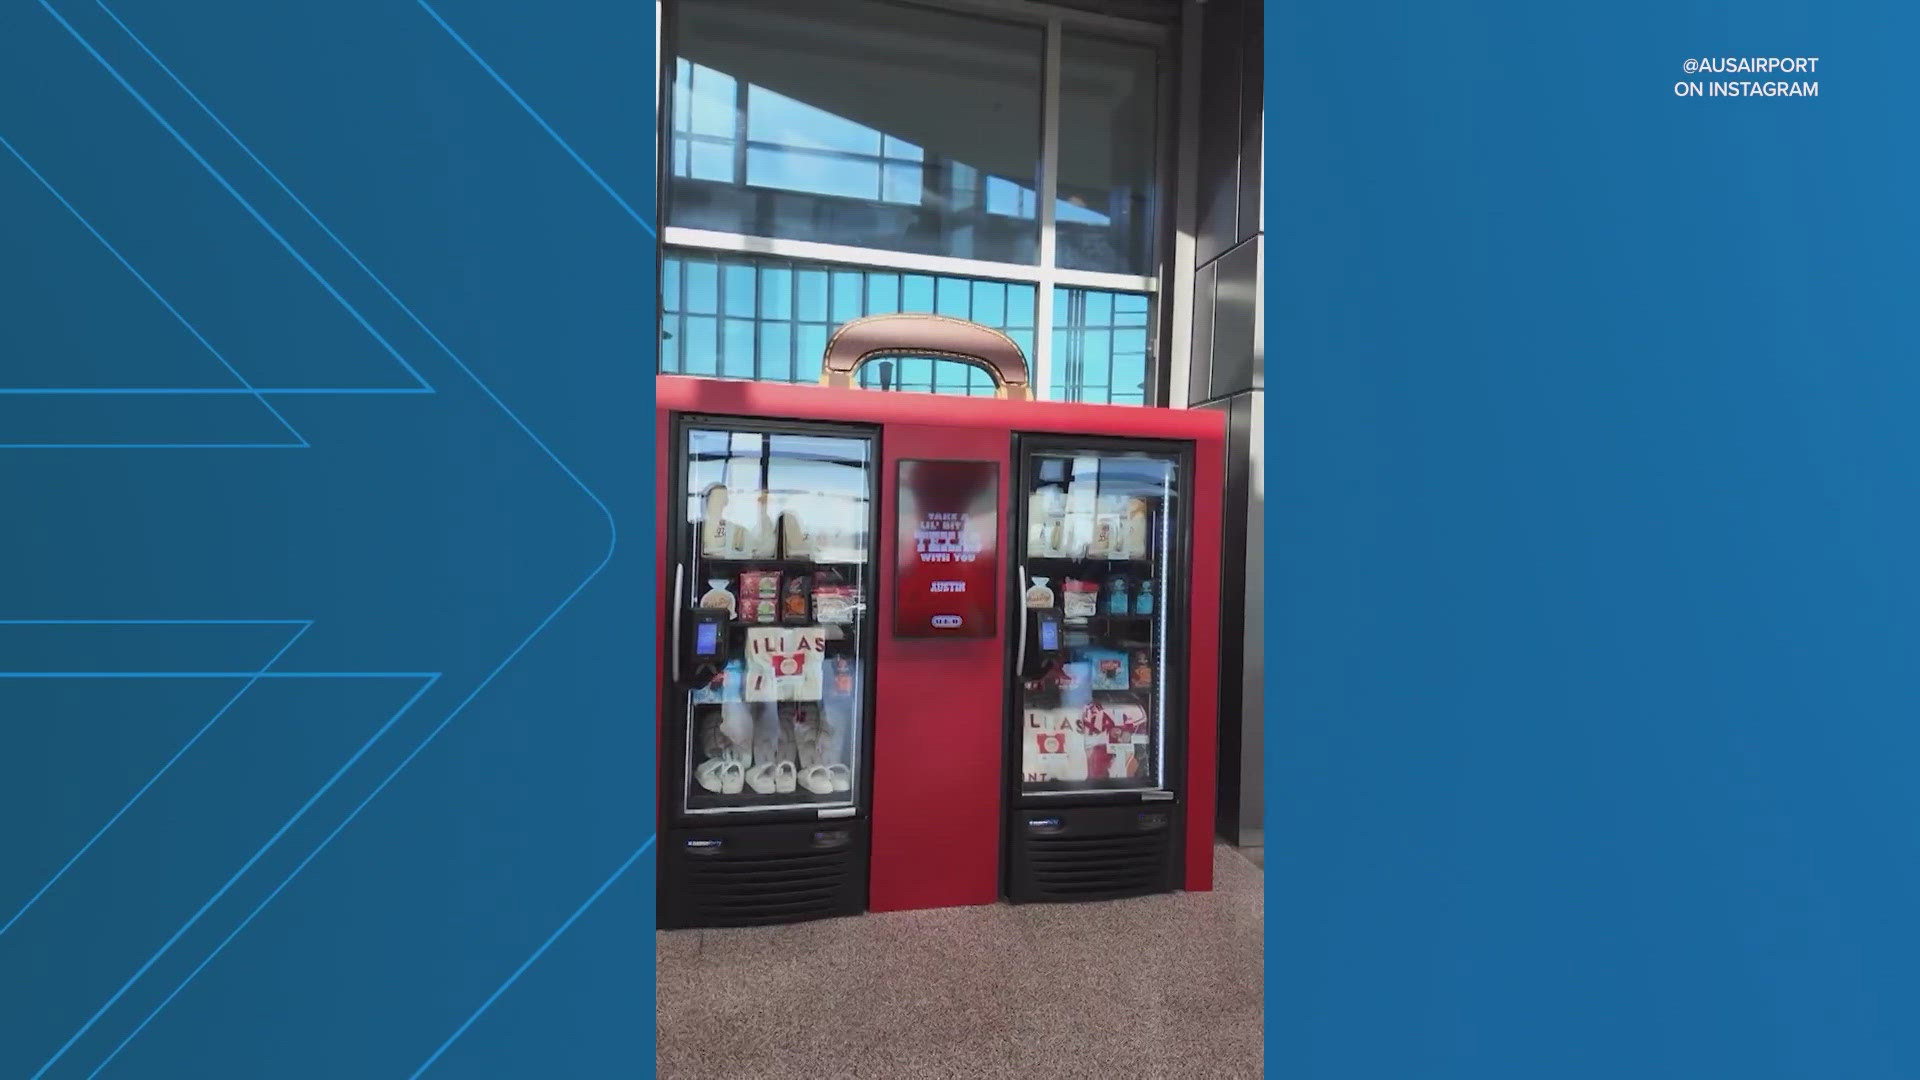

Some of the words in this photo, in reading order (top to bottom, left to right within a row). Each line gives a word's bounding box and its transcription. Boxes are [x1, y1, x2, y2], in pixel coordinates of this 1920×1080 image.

[920, 552, 951, 563] WITH
[953, 552, 976, 563] YOU
[930, 580, 966, 593] AUSTIN
